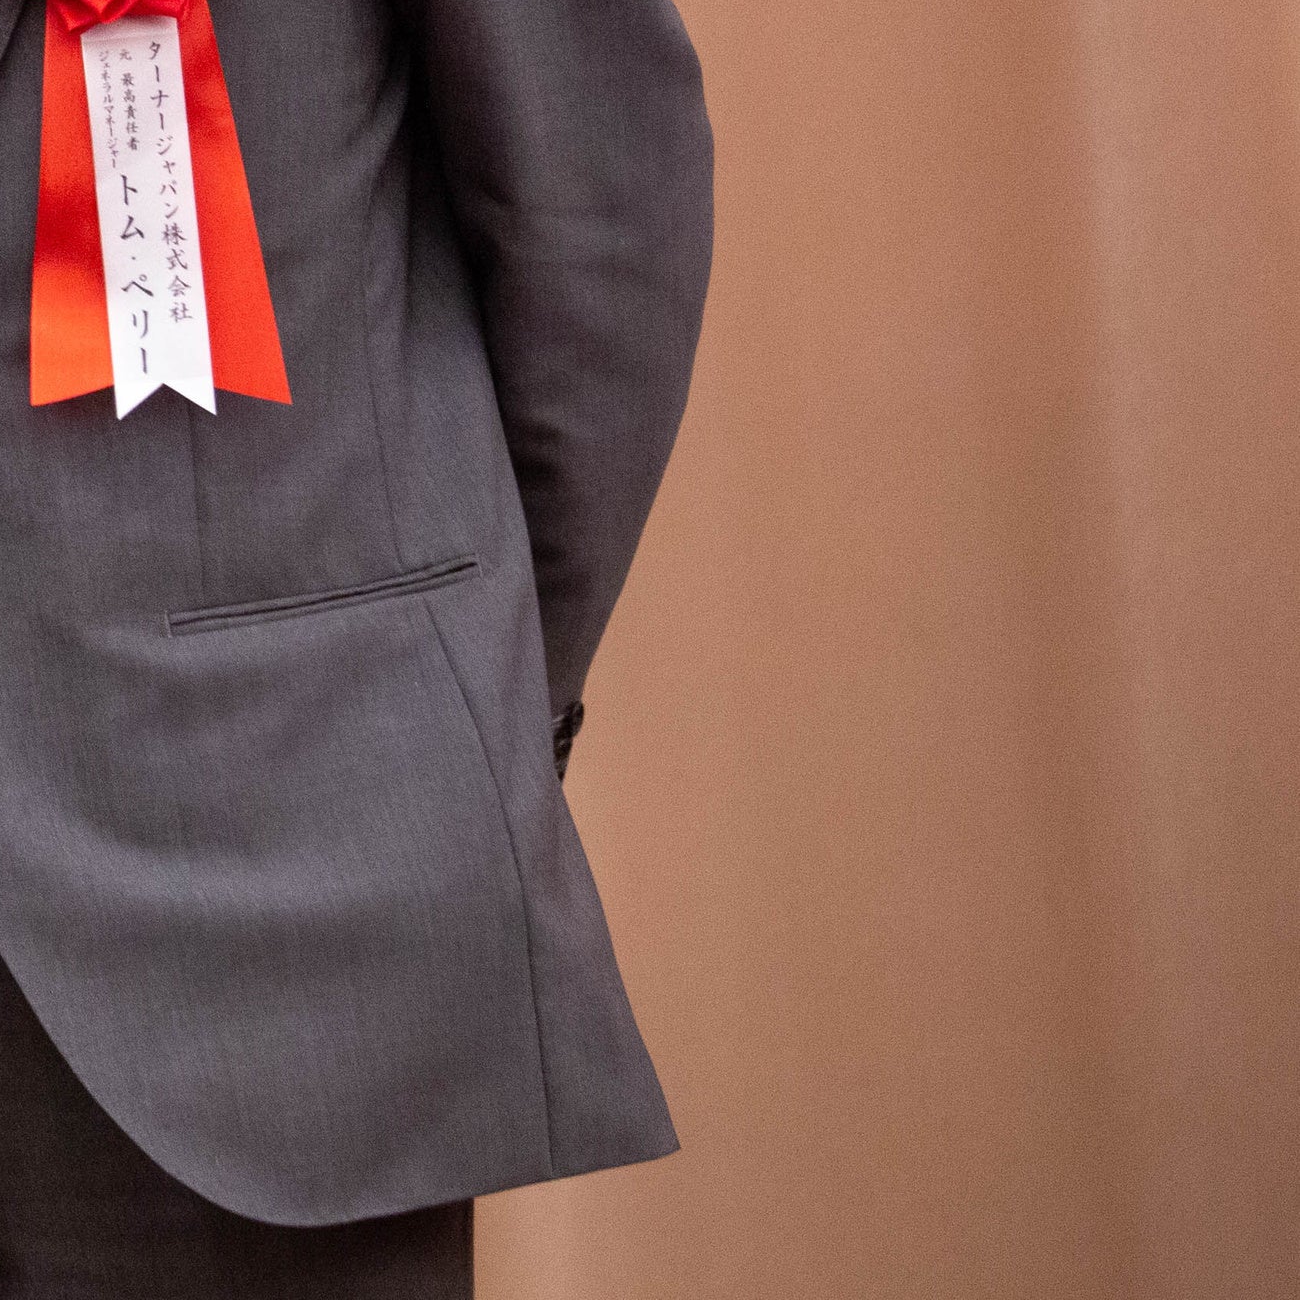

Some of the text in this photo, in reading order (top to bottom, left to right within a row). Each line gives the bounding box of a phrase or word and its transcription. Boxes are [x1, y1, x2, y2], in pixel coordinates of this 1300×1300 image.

[121, 72, 140, 152] 最高責任者
[147, 40, 194, 322] ターナージャパン株式会社
[118, 174, 155, 376] トム・ペリー
